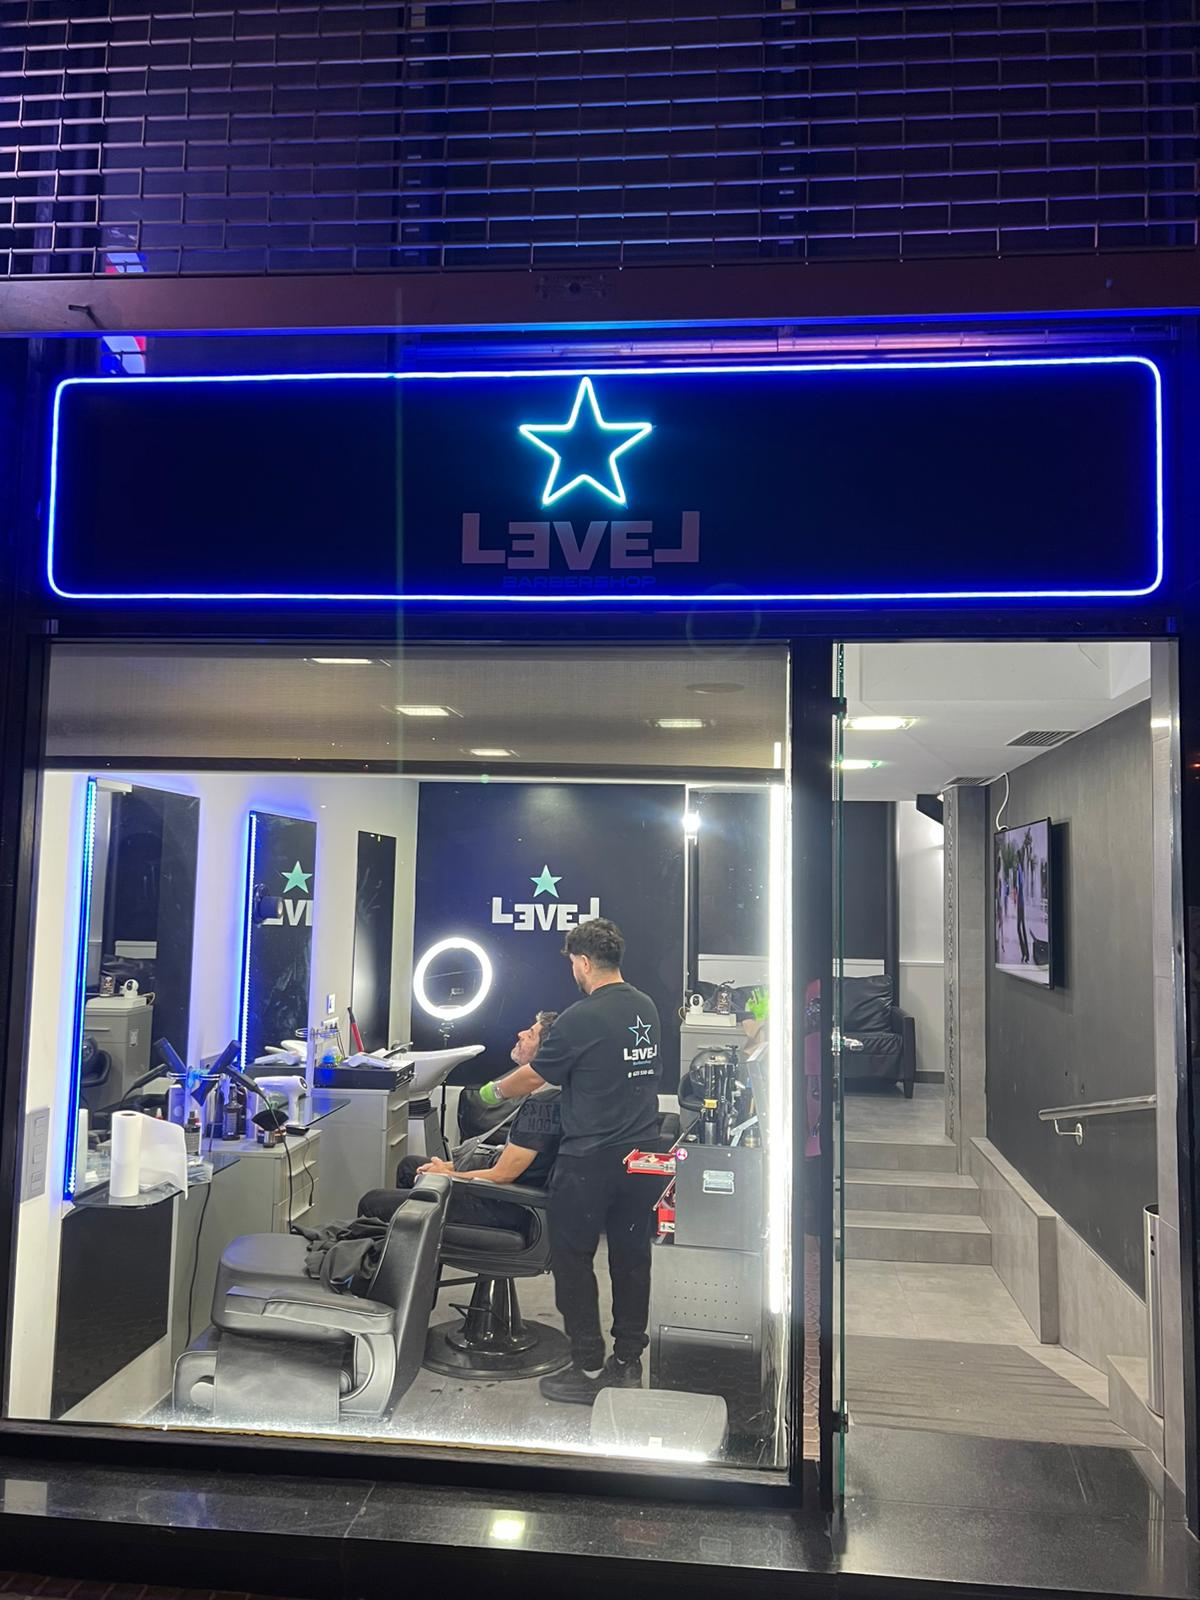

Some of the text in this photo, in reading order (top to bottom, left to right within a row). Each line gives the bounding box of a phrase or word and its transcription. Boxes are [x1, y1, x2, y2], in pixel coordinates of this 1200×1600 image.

[461, 511, 700, 570] LEVEL
[502, 575, 656, 588] BARBERSHOP
[491, 897, 600, 931] LEVEL
[623, 1044, 658, 1061] LEVEL
